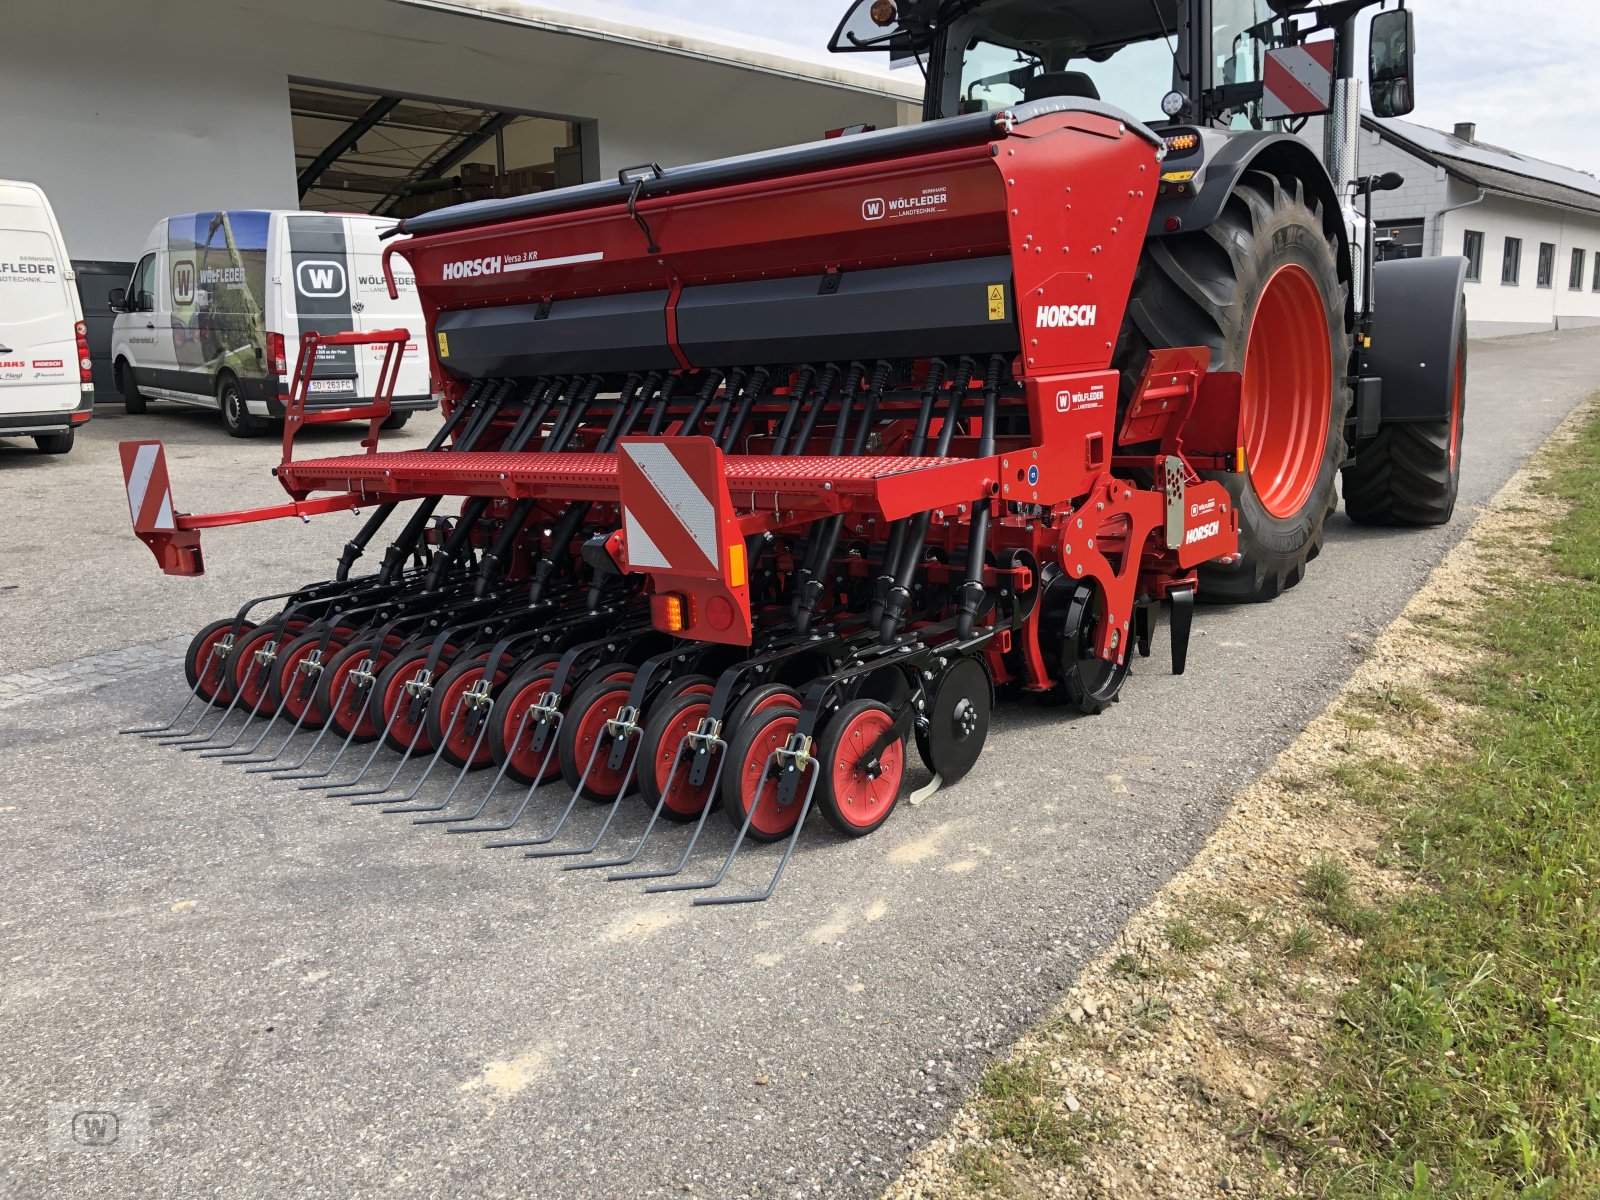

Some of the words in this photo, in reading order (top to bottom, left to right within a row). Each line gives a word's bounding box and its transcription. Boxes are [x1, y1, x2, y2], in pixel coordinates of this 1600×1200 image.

[867, 203, 880, 216] W
[889, 193, 947, 210] WÖLFLEDER
[898, 206, 936, 217] LANDTECHNIK
[200, 266, 246, 284] WÖLFLEDER
[443, 256, 501, 281] HORSCH
[504, 255, 521, 264] Versa
[523, 252, 527, 261] 3
[528, 251, 538, 260] KR
[177, 270, 191, 296] W
[308, 269, 334, 289] W
[1036, 304, 1097, 328] HORSCH
[312, 382, 321, 390] SD
[327, 381, 340, 389] 263
[341, 381, 350, 389] FC
[1072, 391, 1104, 403] WÖLFLEDER
[1185, 520, 1220, 545] HORSCH
